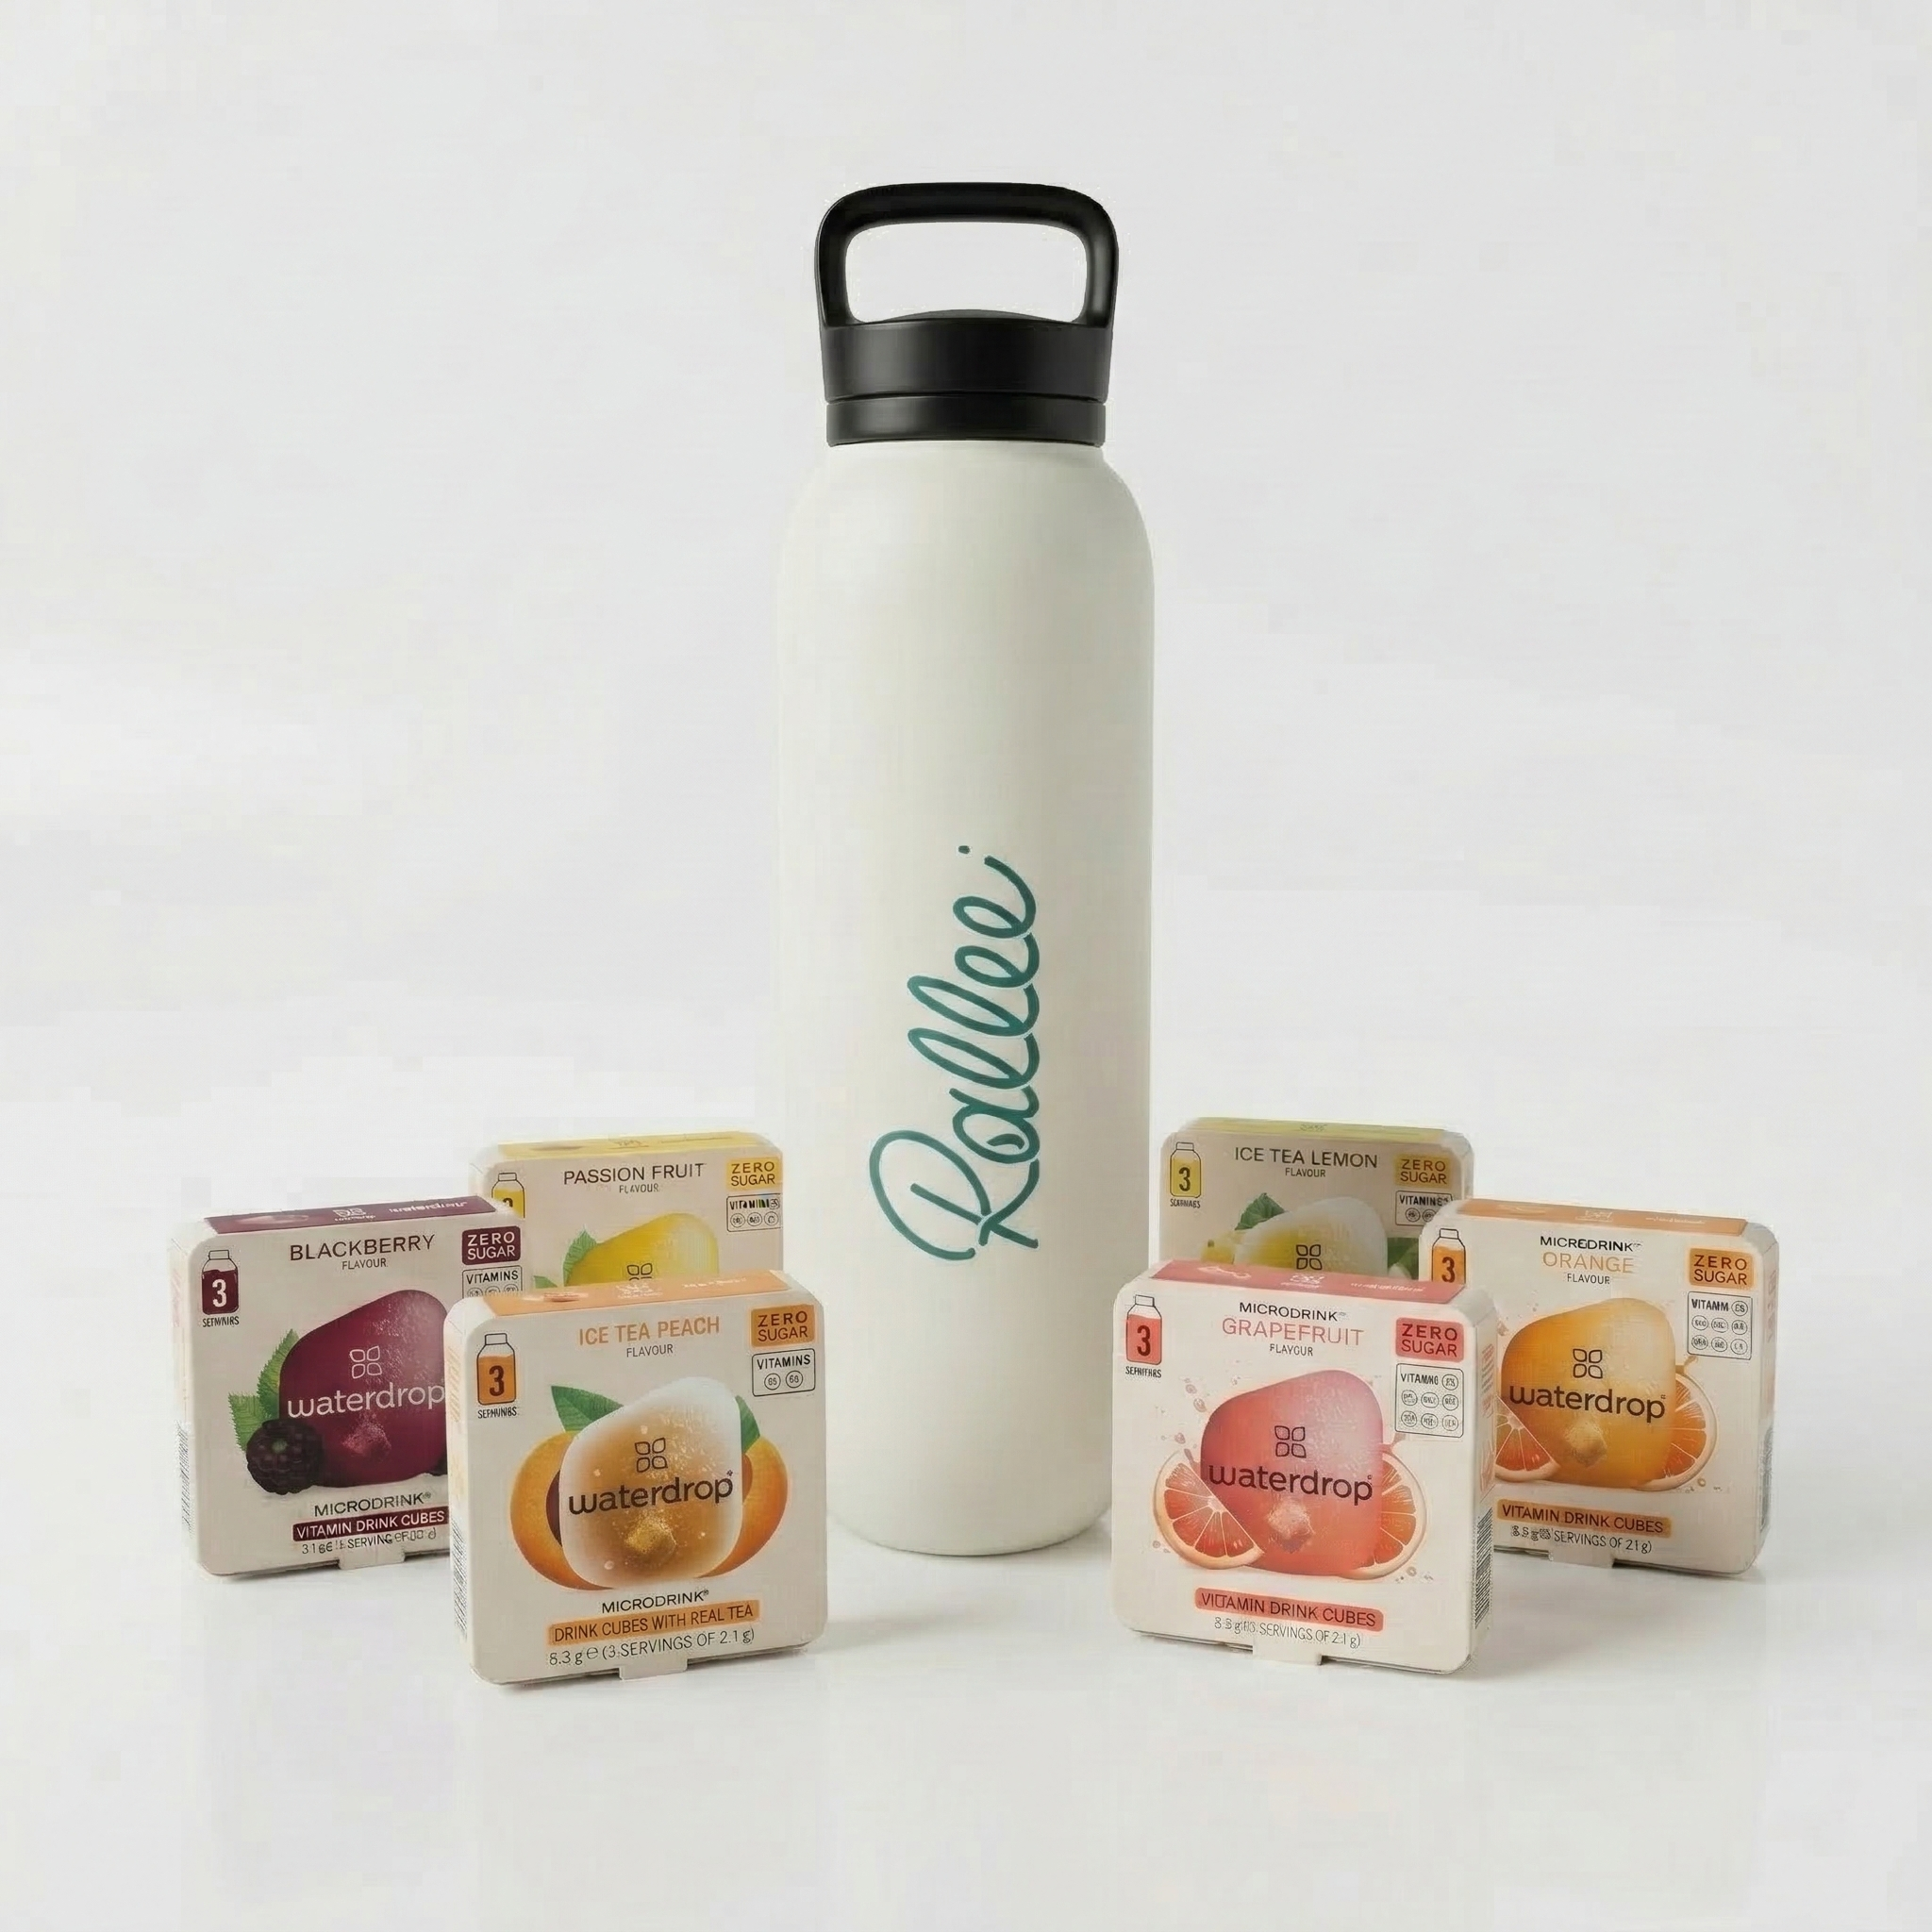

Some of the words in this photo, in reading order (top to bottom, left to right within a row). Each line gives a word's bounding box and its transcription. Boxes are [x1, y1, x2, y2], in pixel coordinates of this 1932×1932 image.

[731, 1161, 774, 1174] ZERO
[1235, 1147, 1264, 1161] ICE
[1269, 1148, 1305, 1164] TEA
[1311, 1150, 1378, 1168] LEMON
[1401, 1158, 1446, 1172] ZERO
[563, 1166, 645, 1185] PASSION
[652, 1163, 706, 1179] FRUIT
[731, 1174, 775, 1186] SUGAR
[1178, 1167, 1191, 1191] 3
[1285, 1167, 1326, 1178] FLAVOUR
[1400, 1172, 1447, 1185] SUGAR
[290, 1234, 435, 1260] BLACKBERRY
[467, 1231, 515, 1246] ZERO
[467, 1245, 516, 1260] SUGAR
[1542, 1252, 1635, 1274] ORANGE
[1694, 1255, 1747, 1271] ZERO
[341, 1257, 387, 1270] FLAVOUR
[1441, 1257, 1455, 1284] 3
[466, 1270, 519, 1284] VITAMINS
[1567, 1274, 1610, 1285] FLAVOUR
[1694, 1269, 1747, 1285] SUGAR
[212, 1279, 227, 1307] 3
[758, 1310, 808, 1327] ZERO
[579, 1326, 608, 1345] ICE
[614, 1322, 650, 1343] TEA
[658, 1316, 720, 1339] PEACH
[758, 1325, 808, 1341] SUGAR
[1137, 1324, 1151, 1357] 3
[1222, 1317, 1364, 1346] GRAPEFRUIT
[1401, 1323, 1458, 1341] ZERO
[626, 1343, 674, 1357] FLAVOUR
[1401, 1339, 1457, 1357] SUGAR
[757, 1354, 811, 1370] VITAMINS
[489, 1365, 505, 1396] 3
[288, 1382, 445, 1418] waterdrop
[1509, 1385, 1666, 1424] waterdrop
[568, 1476, 734, 1515] waterdrop
[1208, 1464, 1374, 1506] waterdrop
[296, 1522, 352, 1539] VITAMIN
[356, 1515, 398, 1532] DRINK
[401, 1510, 445, 1526] CUBES
[1502, 1504, 1559, 1523] VITAMIN
[1564, 1511, 1610, 1528] DRINK
[1614, 1517, 1664, 1533] CUBES
[555, 1624, 598, 1642] DRINK
[602, 1618, 649, 1636] CUBES
[652, 1612, 686, 1630] WITH
[691, 1607, 725, 1624] REAL
[726, 1604, 754, 1620] TEA
[1270, 1601, 1319, 1621] DRINK
[1323, 1607, 1376, 1627] CUBES
[621, 1635, 692, 1657] SERVINGS
[696, 1632, 716, 1647] OF
